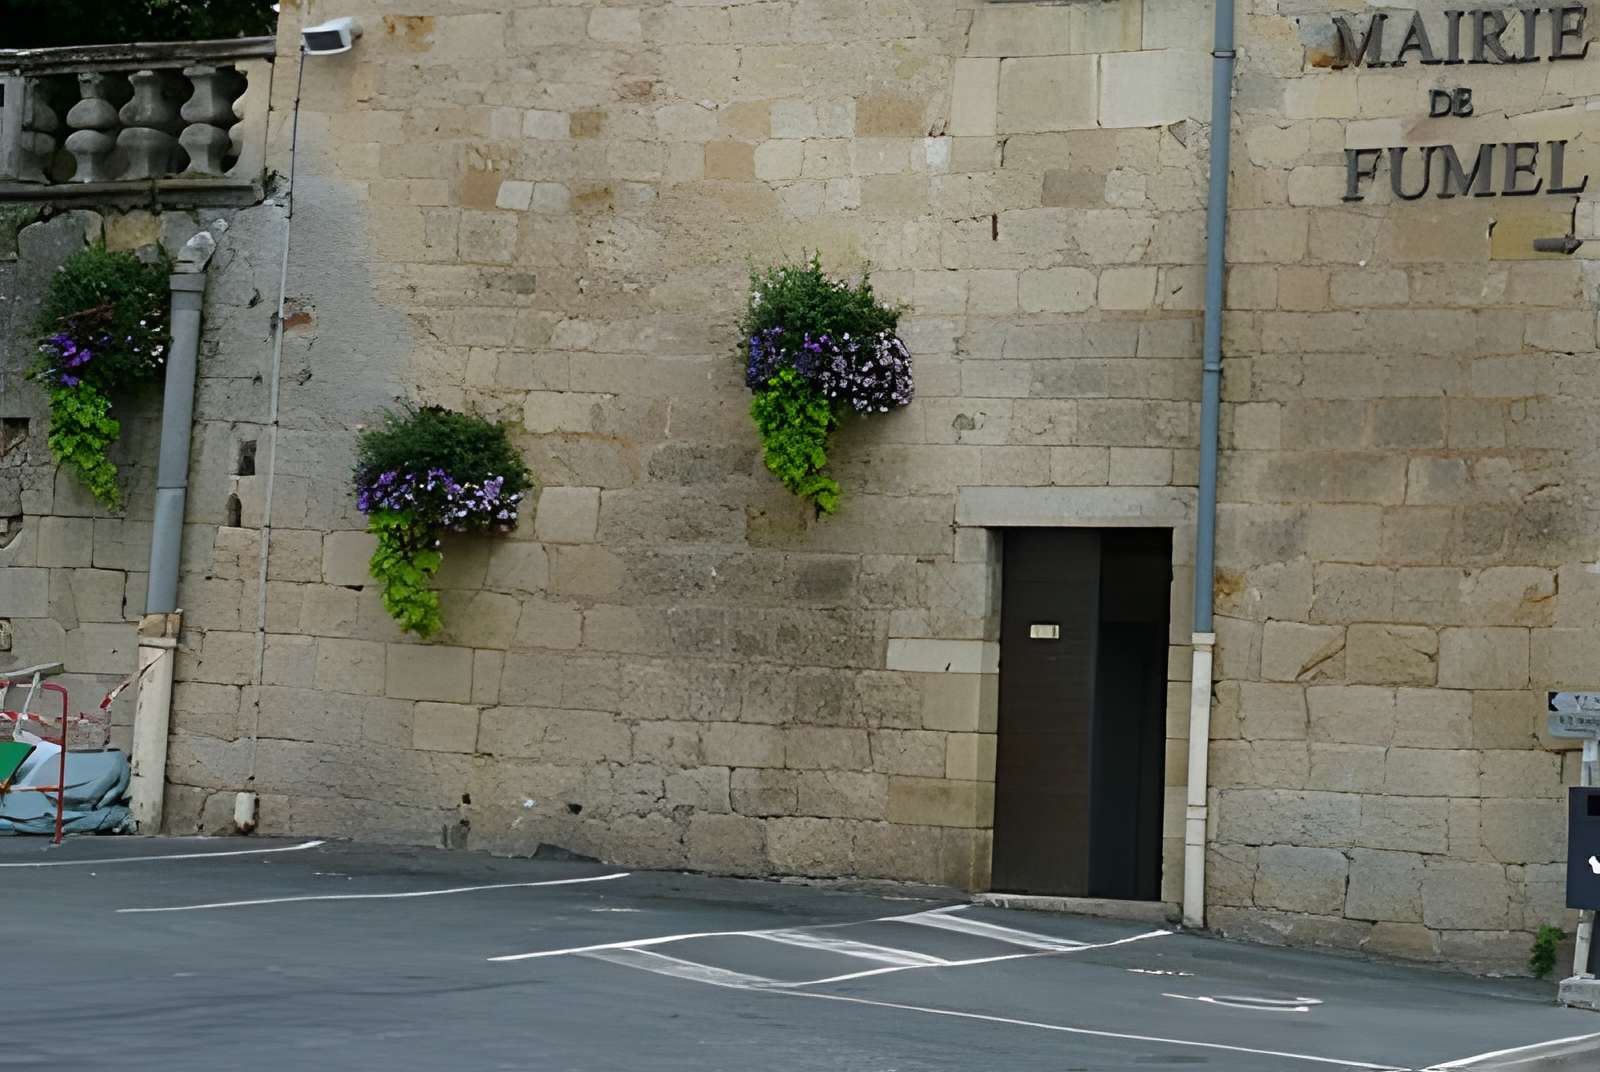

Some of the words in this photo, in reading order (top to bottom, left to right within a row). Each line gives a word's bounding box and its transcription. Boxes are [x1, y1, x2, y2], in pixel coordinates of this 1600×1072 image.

[1332, 7, 1588, 70] MAIRIE
[1428, 88, 1474, 118] DE
[1342, 139, 1589, 202] FUMEL
